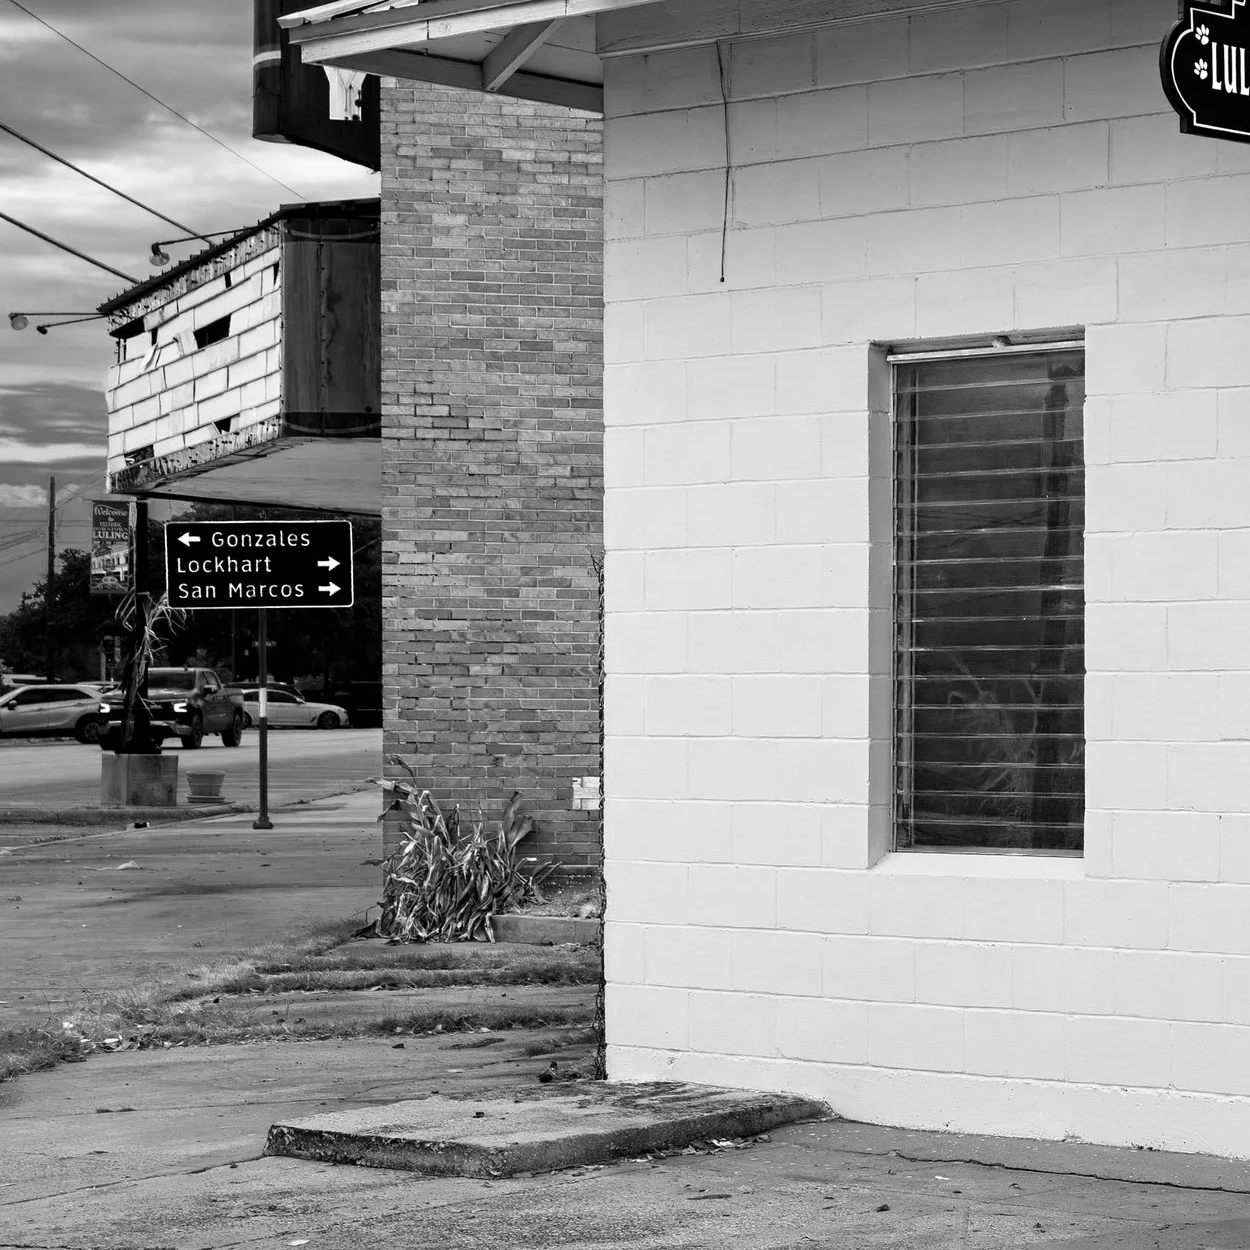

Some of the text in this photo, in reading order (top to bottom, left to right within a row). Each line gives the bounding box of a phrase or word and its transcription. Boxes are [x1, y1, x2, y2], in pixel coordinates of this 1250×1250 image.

[94, 506, 128, 517] Welcome
[93, 531, 128, 540] LULING
[212, 530, 310, 548] Gonzales
[177, 556, 272, 573] Lockhart
[179, 583, 304, 599] San Marcos
